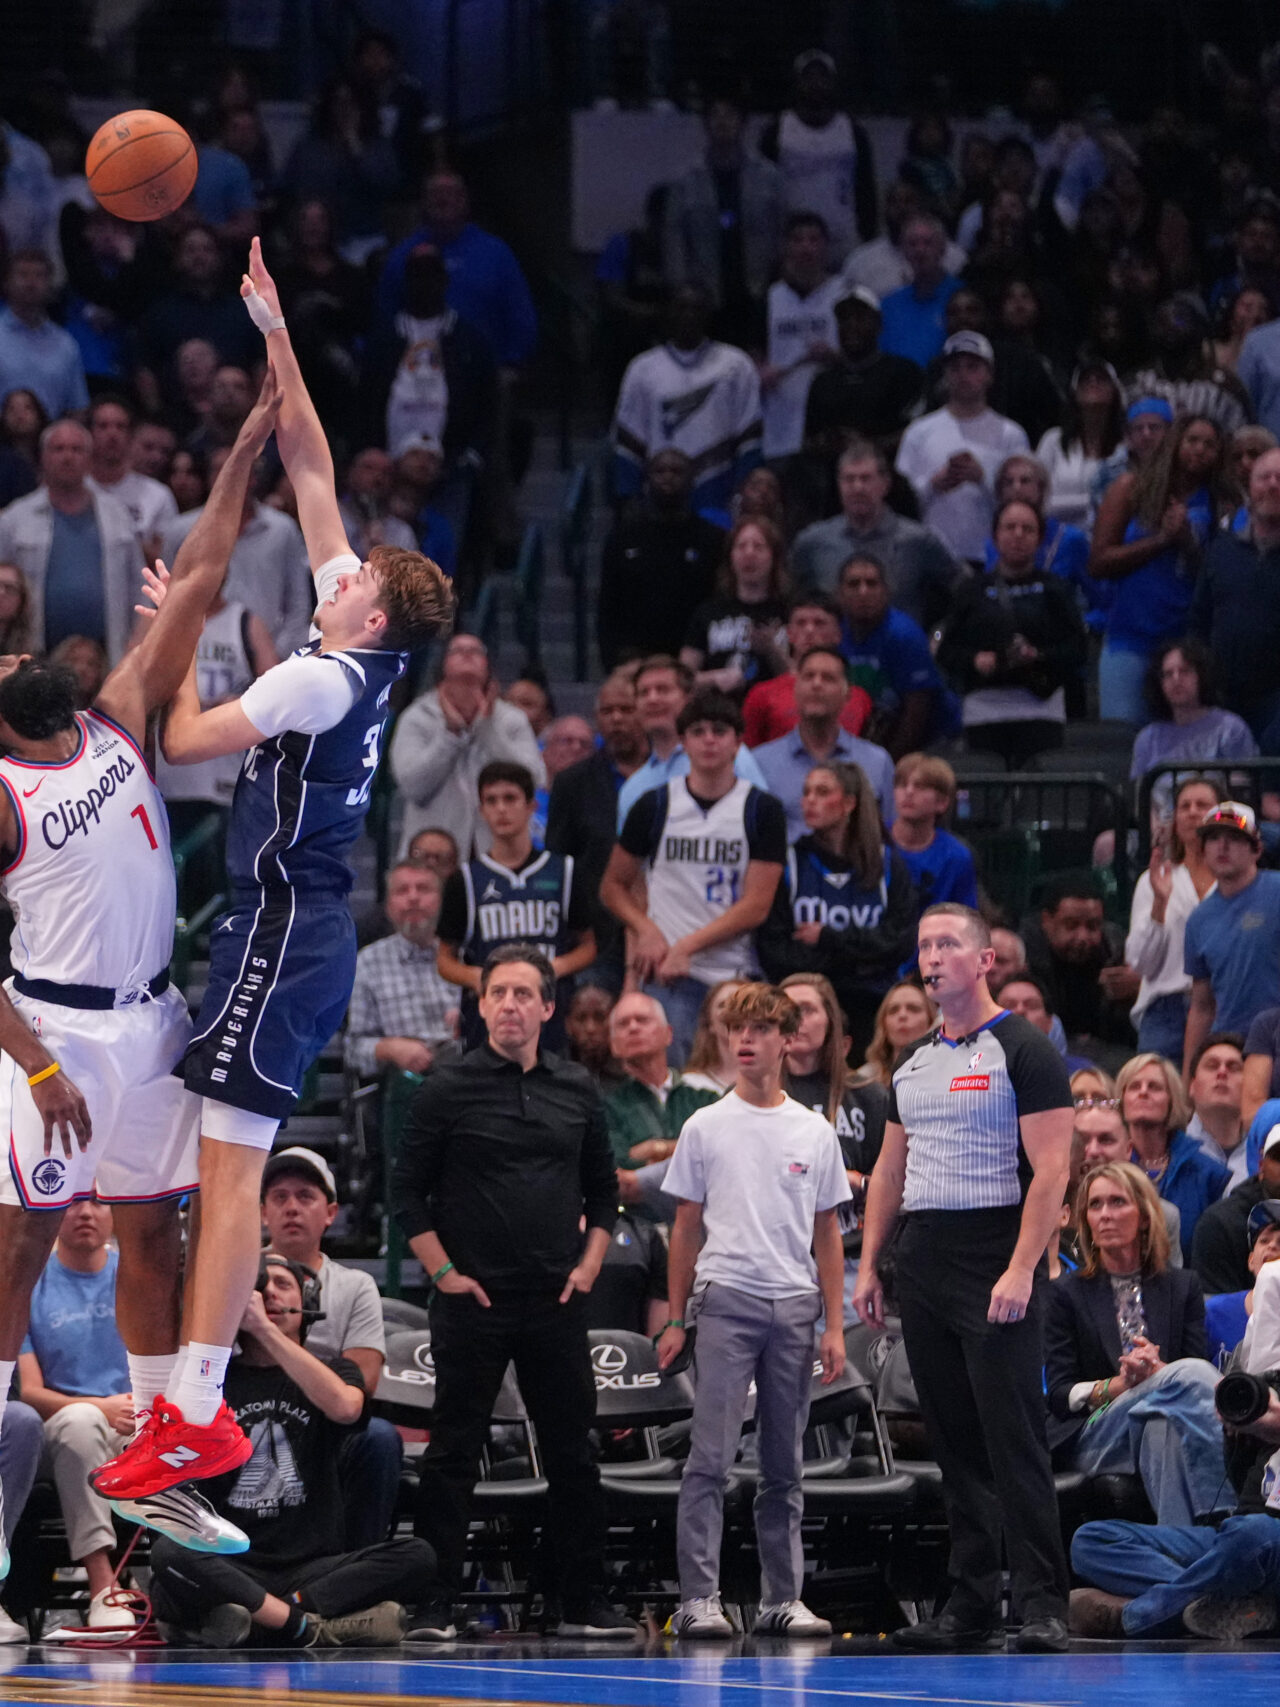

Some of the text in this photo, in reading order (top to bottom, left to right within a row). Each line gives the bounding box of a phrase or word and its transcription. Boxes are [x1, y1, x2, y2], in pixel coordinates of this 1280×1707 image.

[93, 740, 109, 753] VISIT
[41, 755, 135, 850] Clippers
[130, 803, 158, 850] 1
[665, 838, 743, 864] DALLAS
[706, 867, 739, 905] 21
[478, 900, 560, 941] MAVS
[951, 1077, 988, 1090] Emirates
[279, 1401, 311, 1425] PLAZA
